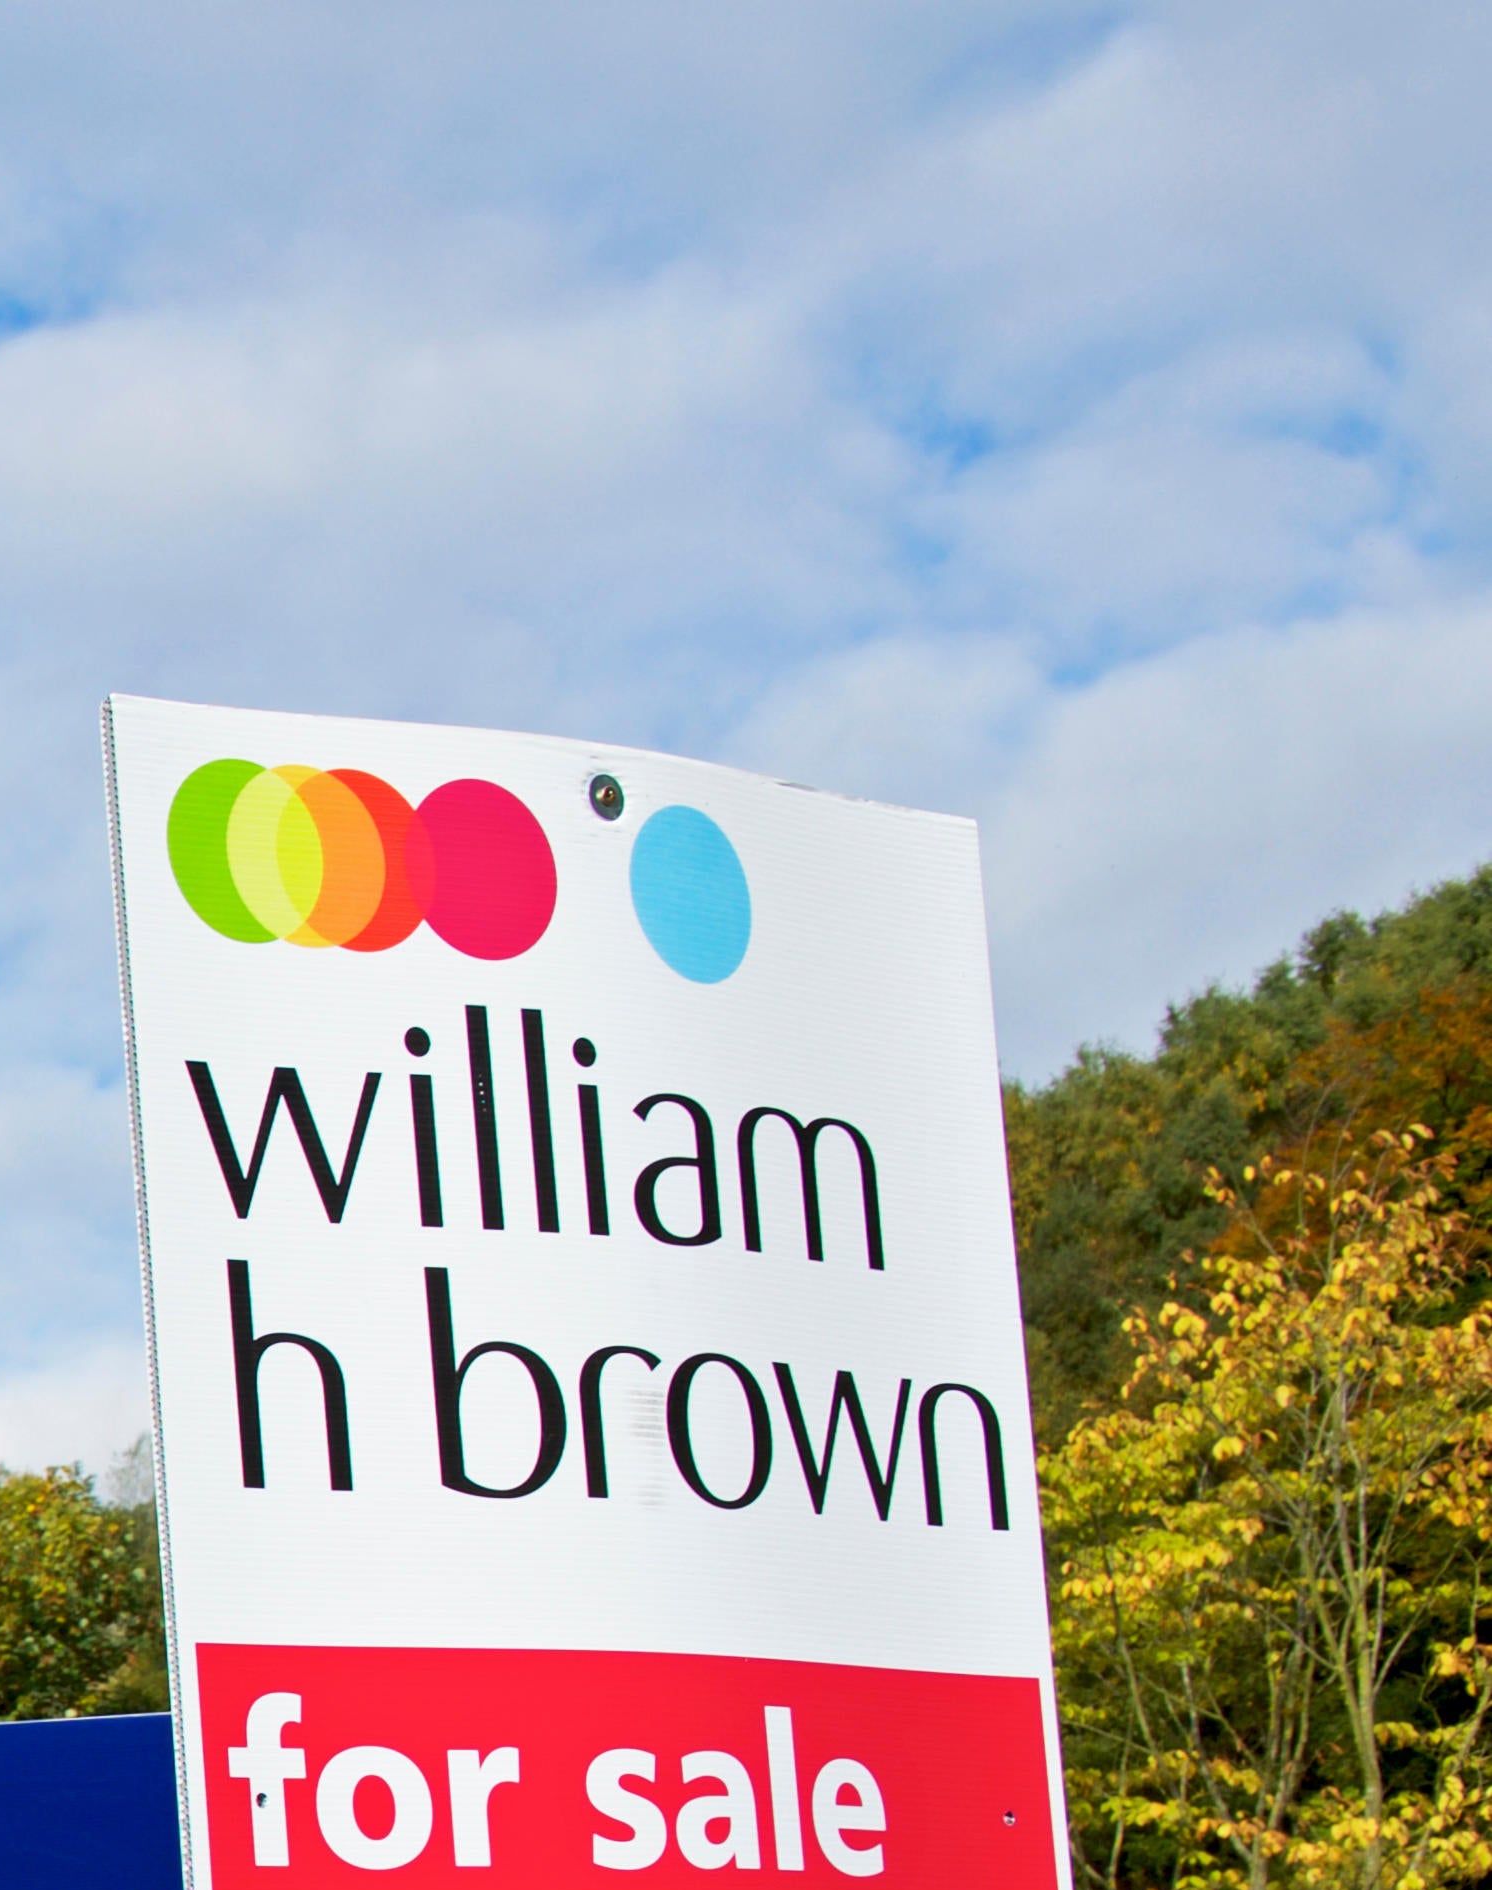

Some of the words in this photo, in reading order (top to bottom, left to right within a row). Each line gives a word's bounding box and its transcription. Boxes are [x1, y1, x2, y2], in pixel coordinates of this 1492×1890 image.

[186, 1004, 885, 1271] william
[227, 1260, 353, 1492] h
[425, 1265, 1010, 1531] brown
[228, 1692, 520, 1870] for
[586, 1706, 887, 1876] sale
